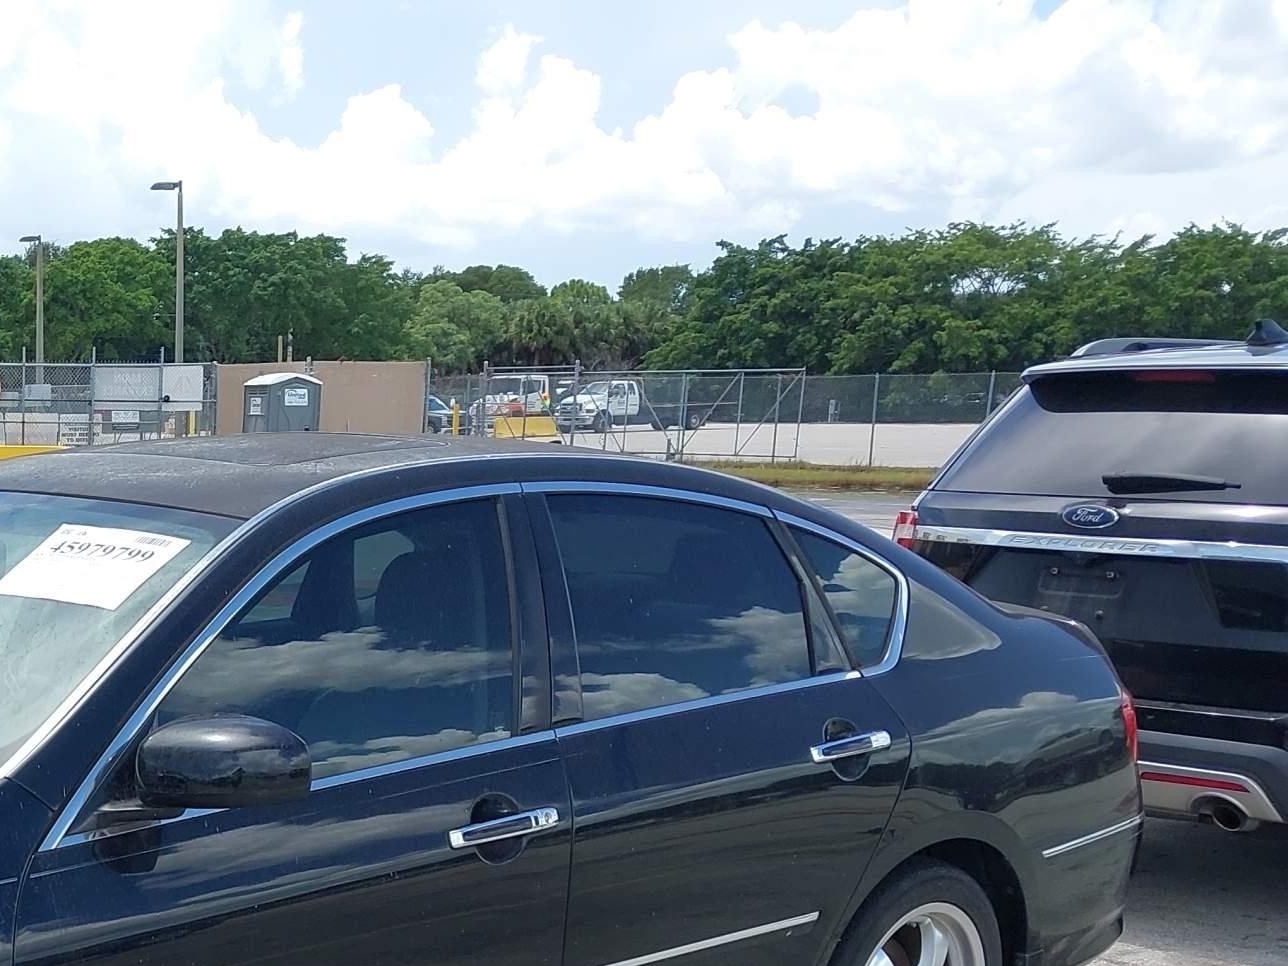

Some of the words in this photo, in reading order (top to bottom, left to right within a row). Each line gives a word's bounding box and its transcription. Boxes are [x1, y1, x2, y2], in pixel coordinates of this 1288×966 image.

[1071, 507, 1105, 523] Ford
[50, 541, 155, 563] 45979799
[1011, 533, 1158, 554] EXPLORER
